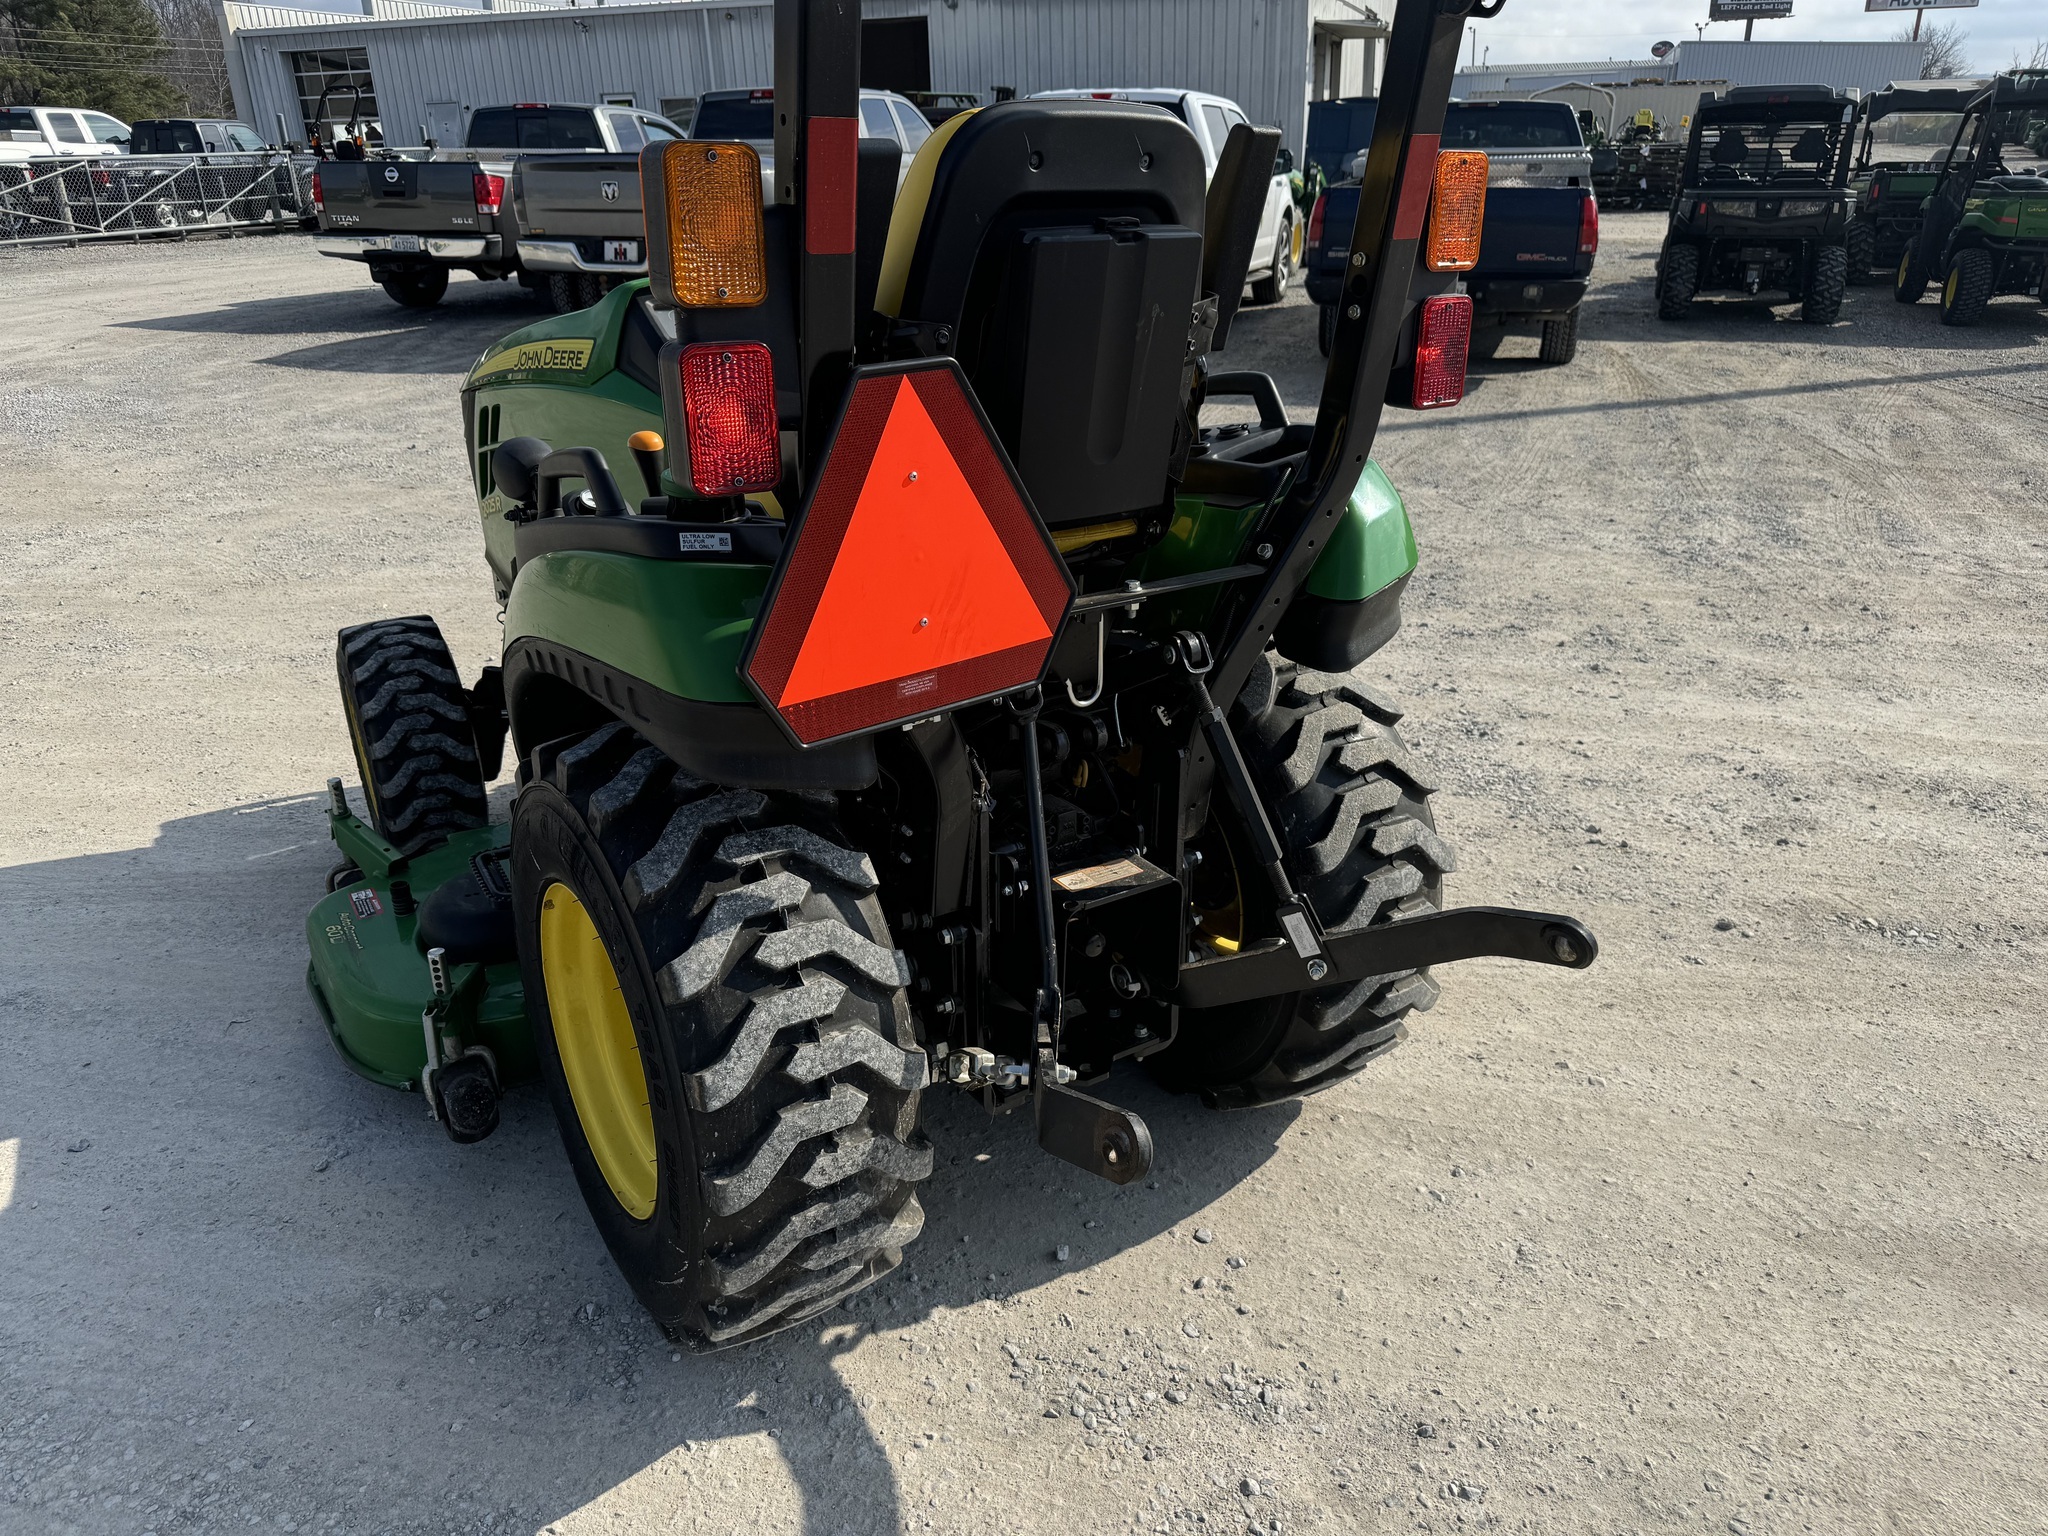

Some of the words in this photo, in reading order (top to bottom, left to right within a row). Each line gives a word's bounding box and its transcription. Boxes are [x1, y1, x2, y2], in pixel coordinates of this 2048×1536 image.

[330, 214, 360, 222] TITAN
[1516, 253, 1546, 261] GMC
[513, 348, 543, 369] JOHN
[543, 346, 585, 369] DEERE
